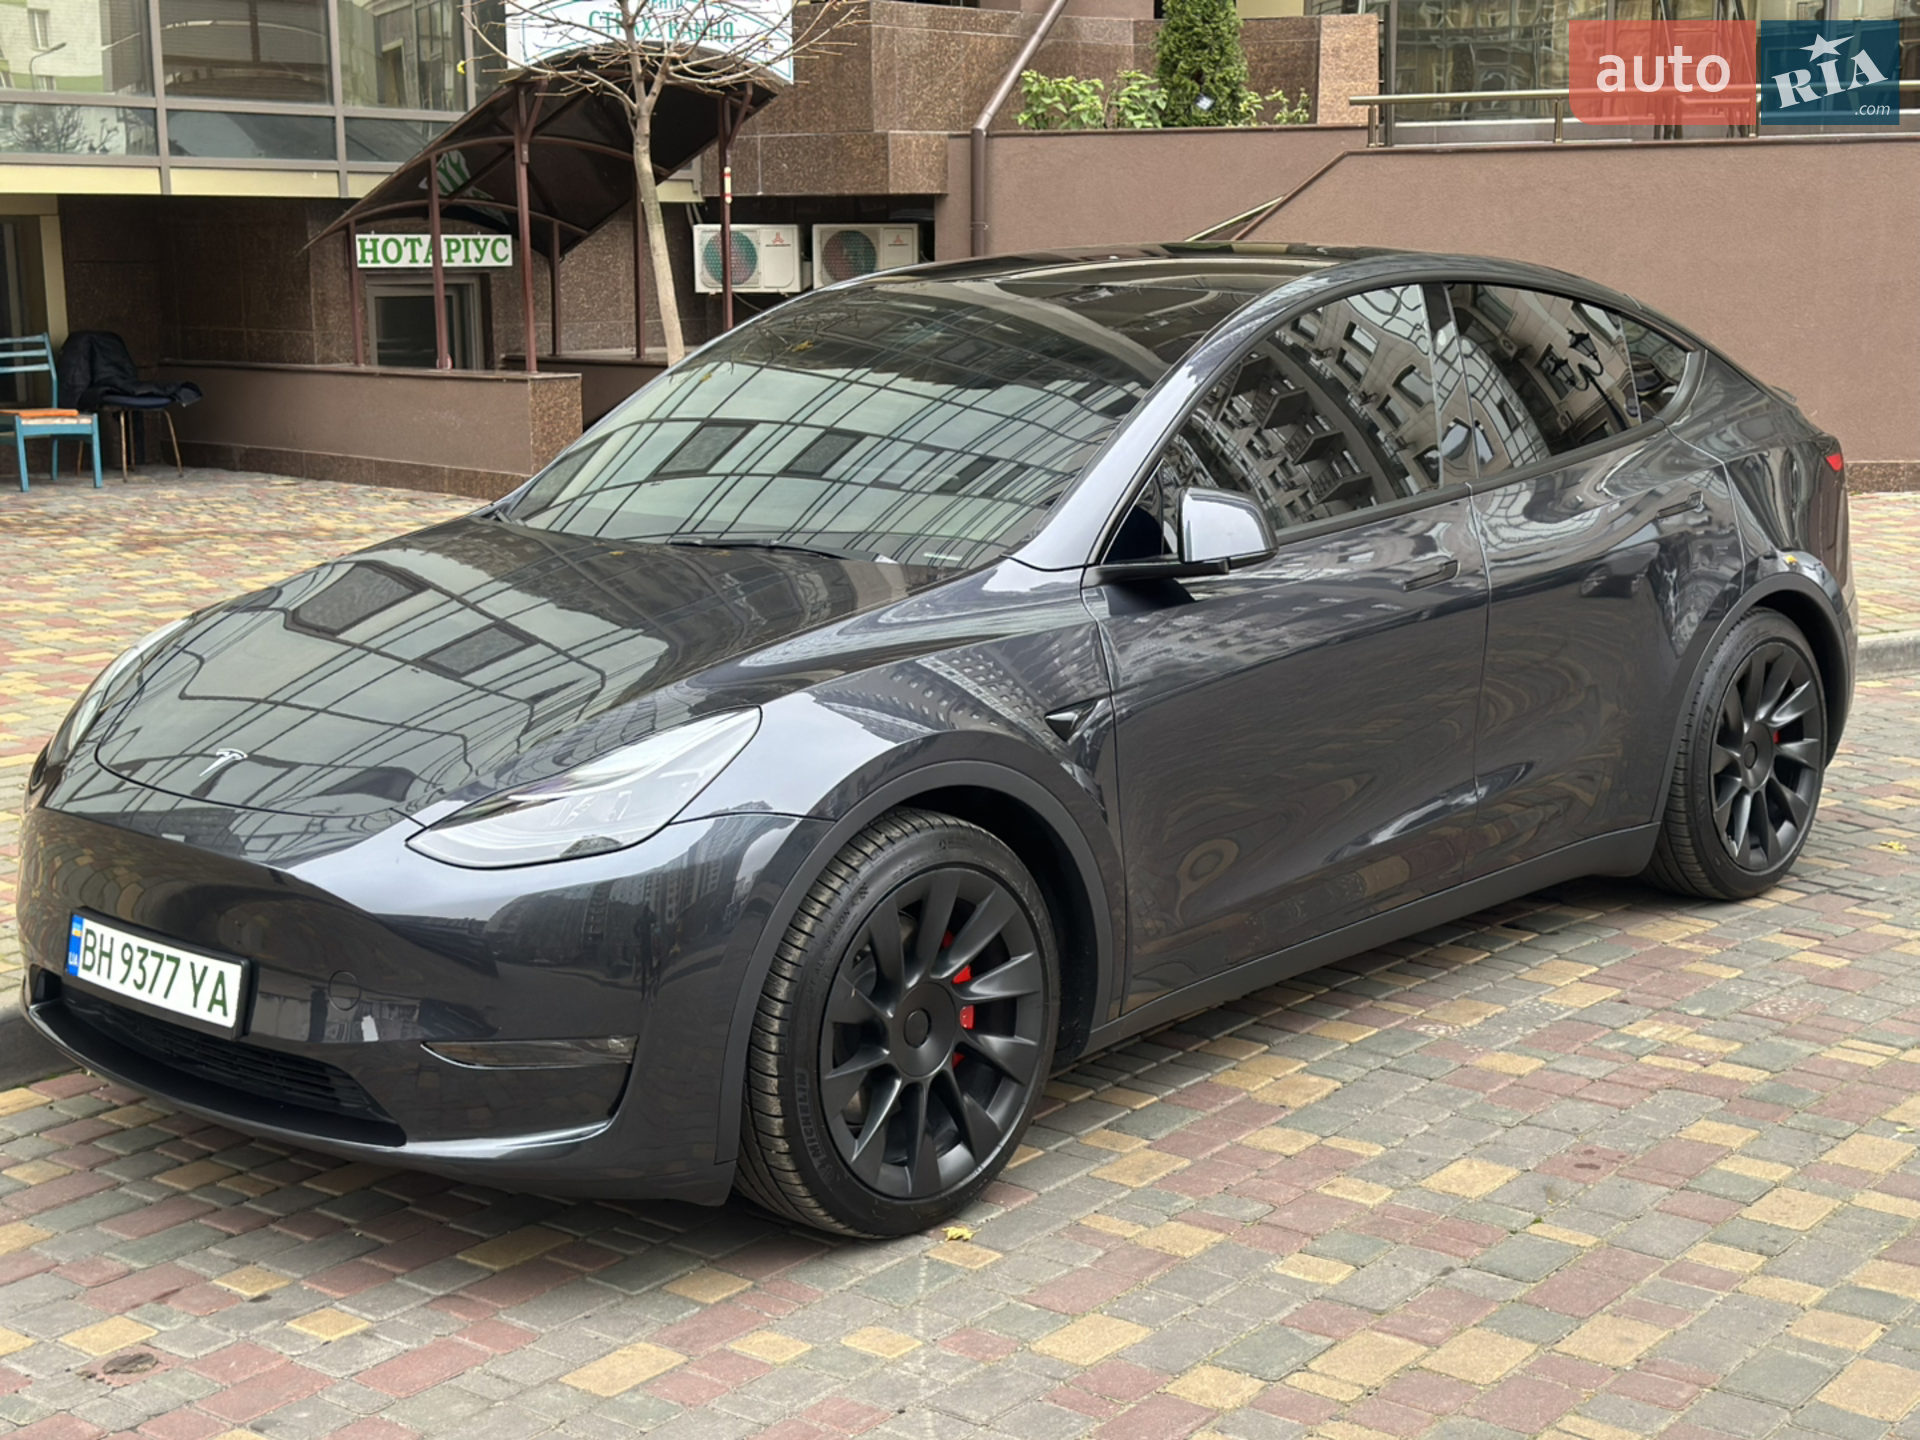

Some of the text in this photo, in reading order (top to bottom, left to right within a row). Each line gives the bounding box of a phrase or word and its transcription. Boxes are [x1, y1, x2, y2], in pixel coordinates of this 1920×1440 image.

[82, 928, 228, 1018] BH 9377 YA
[796, 1072, 822, 1159] MICHELIN
